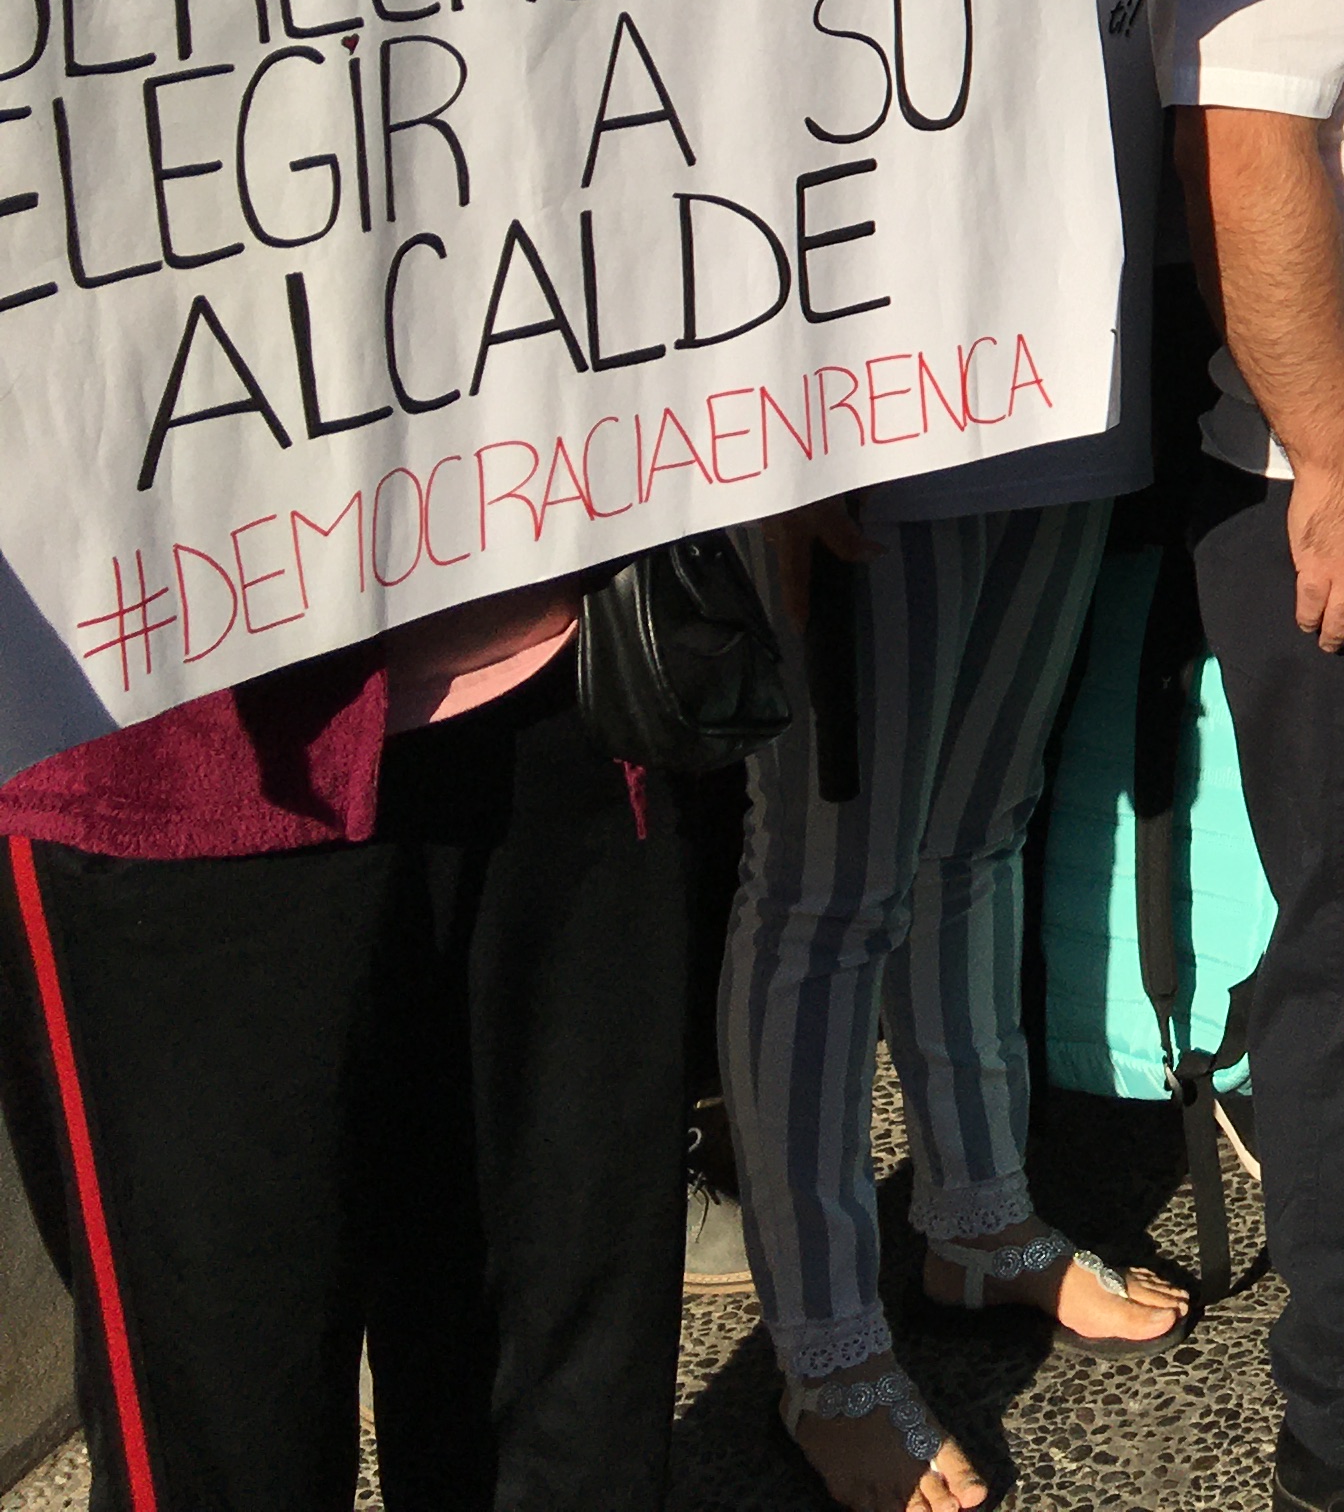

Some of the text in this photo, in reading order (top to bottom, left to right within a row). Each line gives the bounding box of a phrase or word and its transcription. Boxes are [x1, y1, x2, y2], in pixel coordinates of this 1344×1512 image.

[580, 11, 696, 188] A
[136, 158, 892, 492] ALCALDE
[76, 333, 1054, 692] #DEMOCRACIAENRENCA
